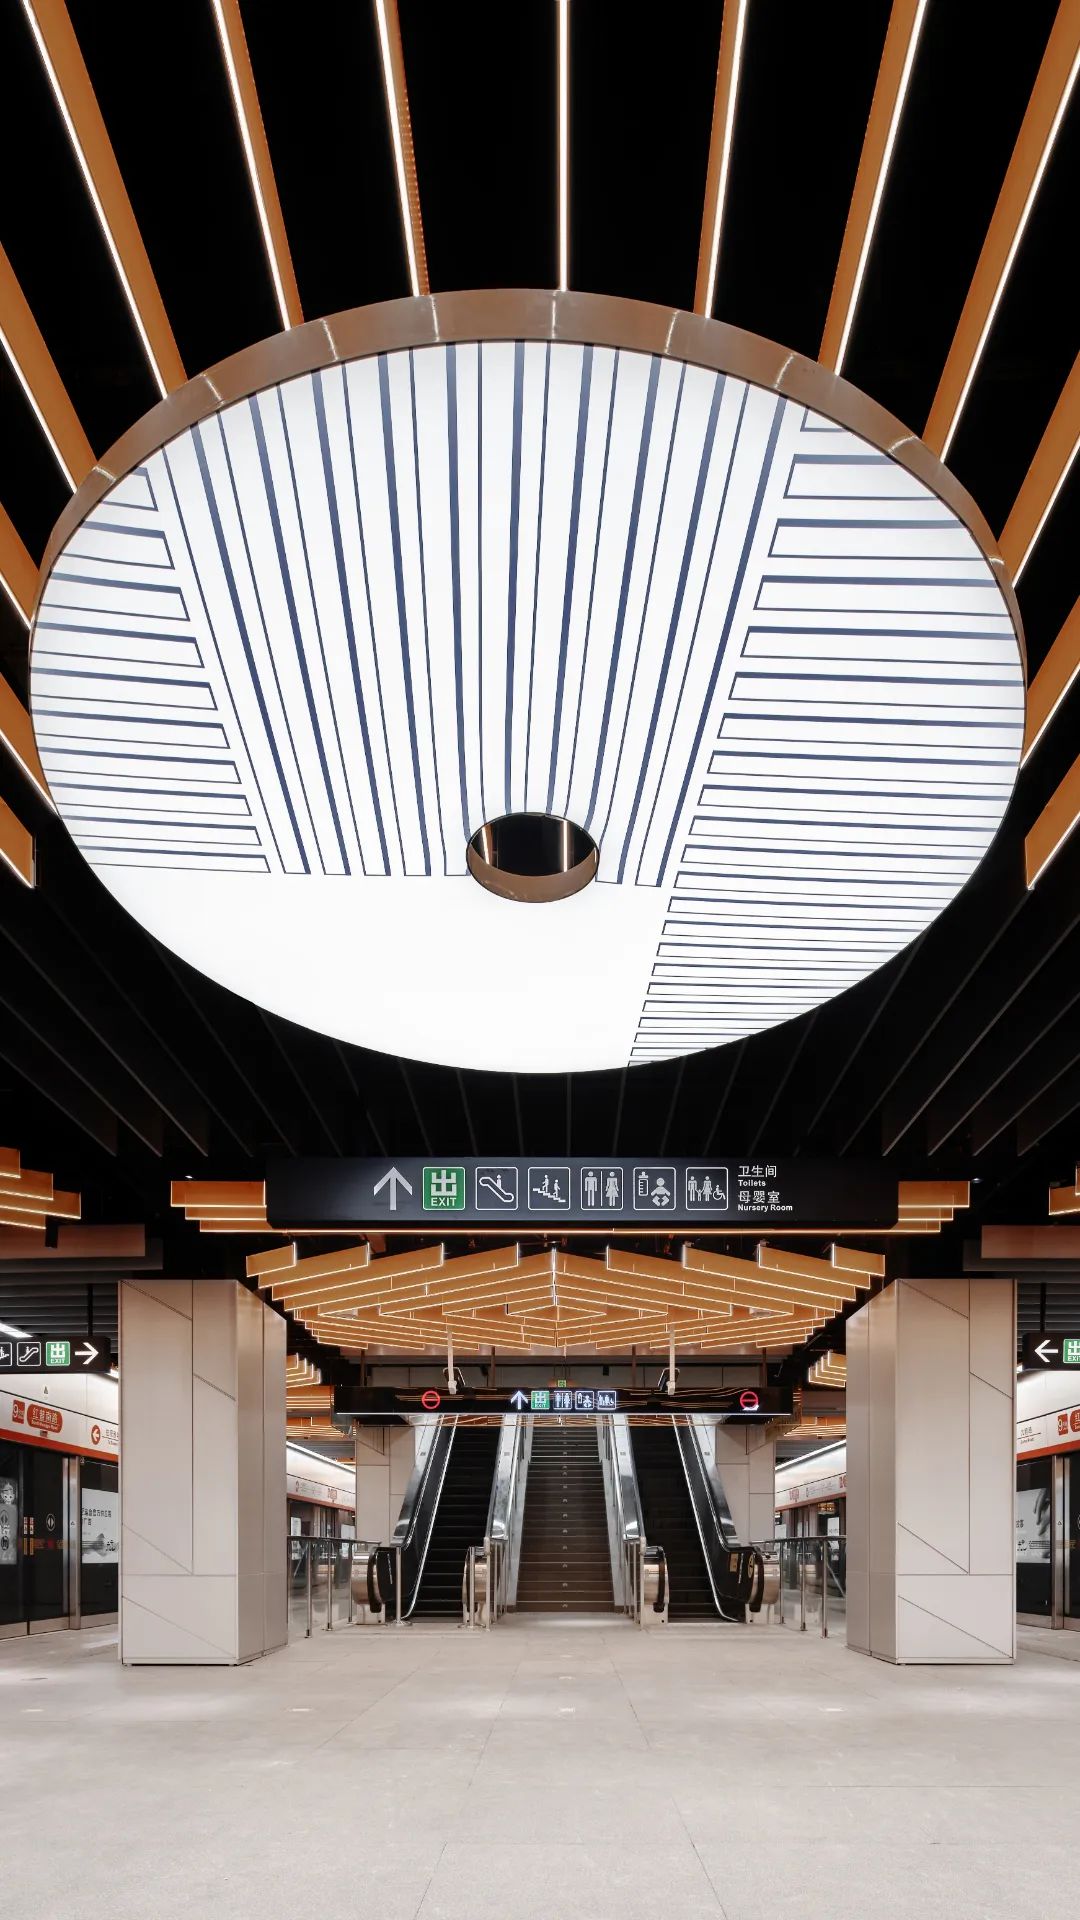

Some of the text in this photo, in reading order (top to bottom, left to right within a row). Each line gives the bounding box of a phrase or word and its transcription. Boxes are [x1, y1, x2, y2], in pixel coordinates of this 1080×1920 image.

[738, 1165, 777, 1178] 卫生间
[431, 1170, 457, 1196] 出
[431, 1197, 457, 1206] EXIT
[738, 1190, 780, 1204] 母婴室
[738, 1204, 768, 1212] Nursery
[50, 1343, 65, 1358] 出
